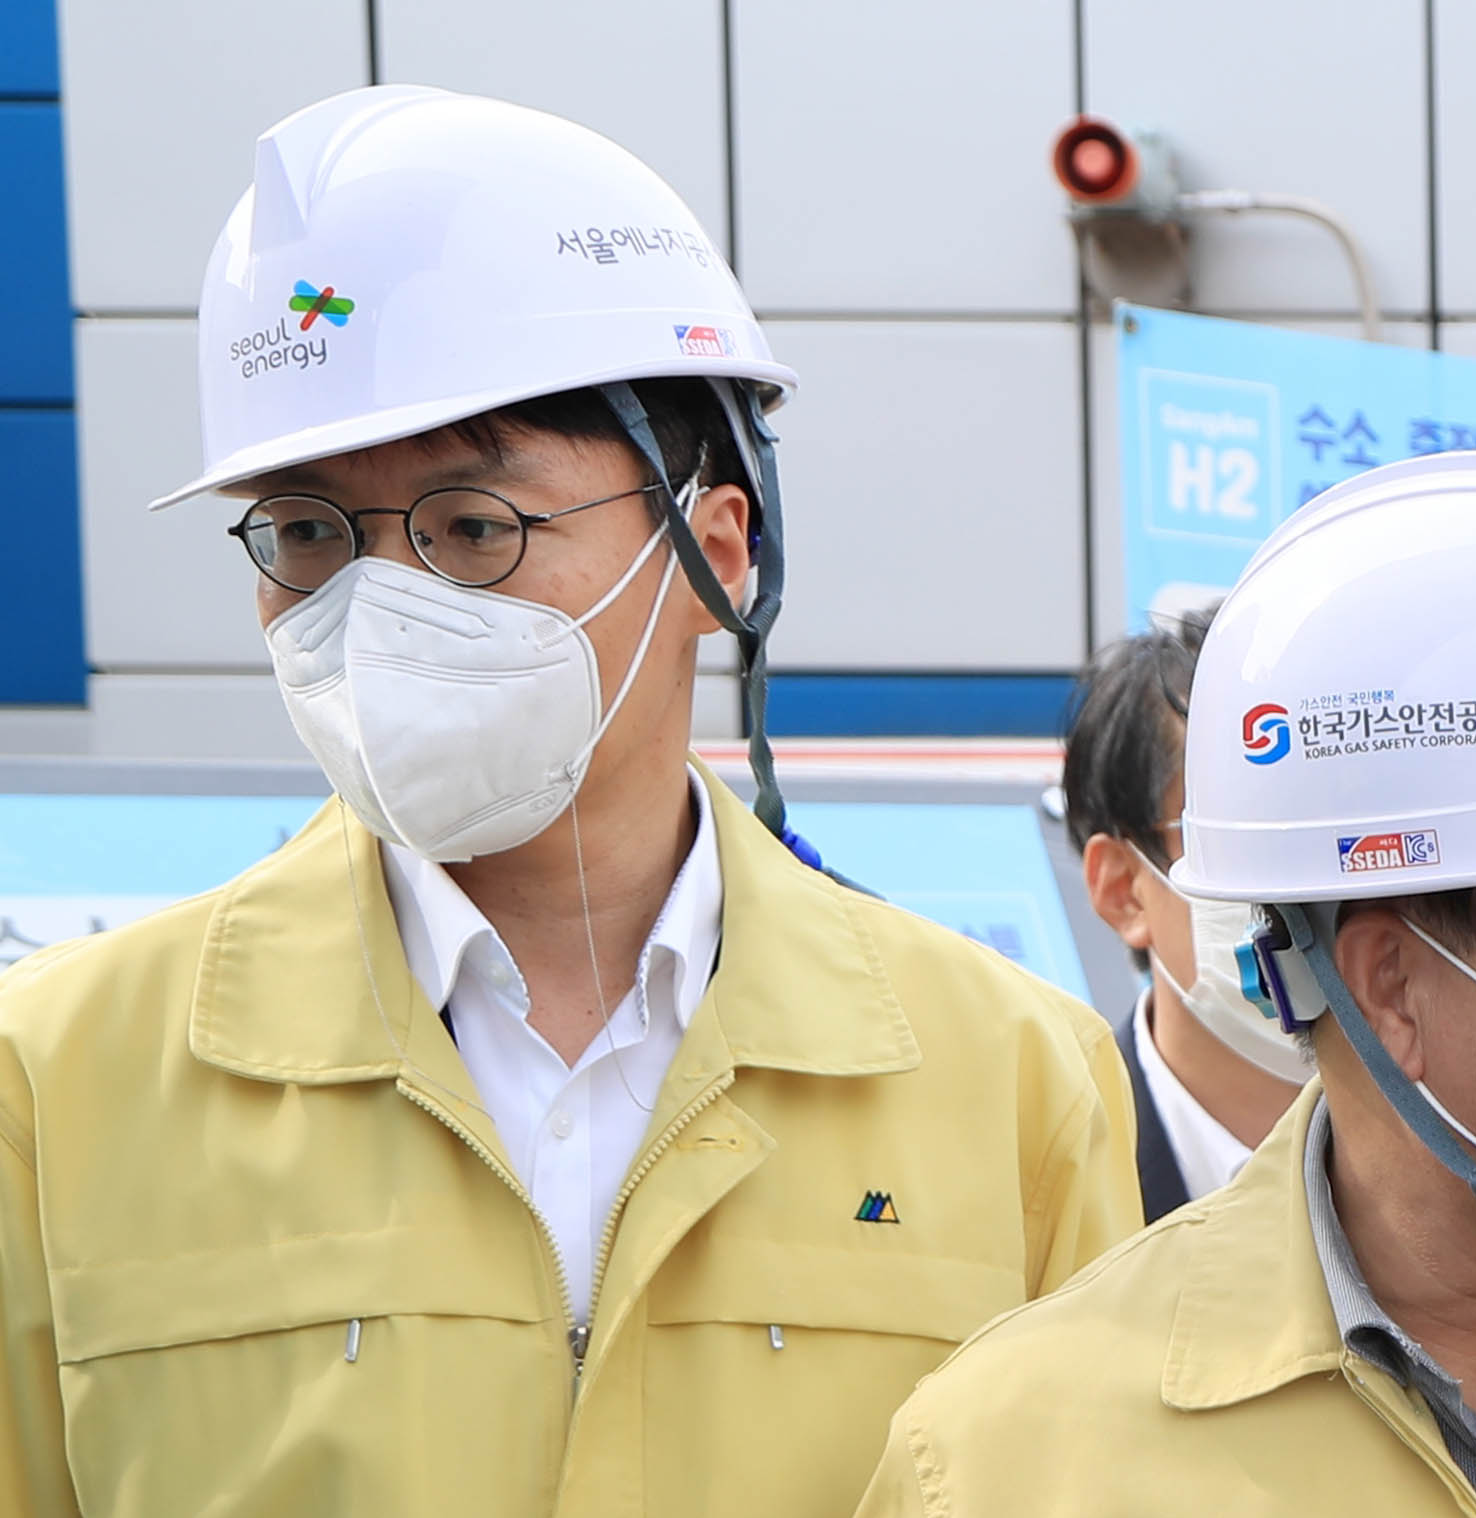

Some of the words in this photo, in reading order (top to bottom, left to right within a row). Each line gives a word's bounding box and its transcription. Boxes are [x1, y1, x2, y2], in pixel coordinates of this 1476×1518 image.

[557, 225, 712, 267] 서울에너지공
[230, 317, 292, 361] seoul
[242, 338, 327, 378] energy
[1297, 403, 1380, 468] 수소
[1168, 440, 1260, 521] H2
[1299, 694, 1343, 711] 가스안전
[1347, 689, 1395, 706] 국민행복
[1305, 744, 1342, 761] KOREA
[1344, 740, 1370, 755] GAS
[1372, 736, 1417, 752] SAFETY
[1340, 848, 1403, 871] SSEDA
